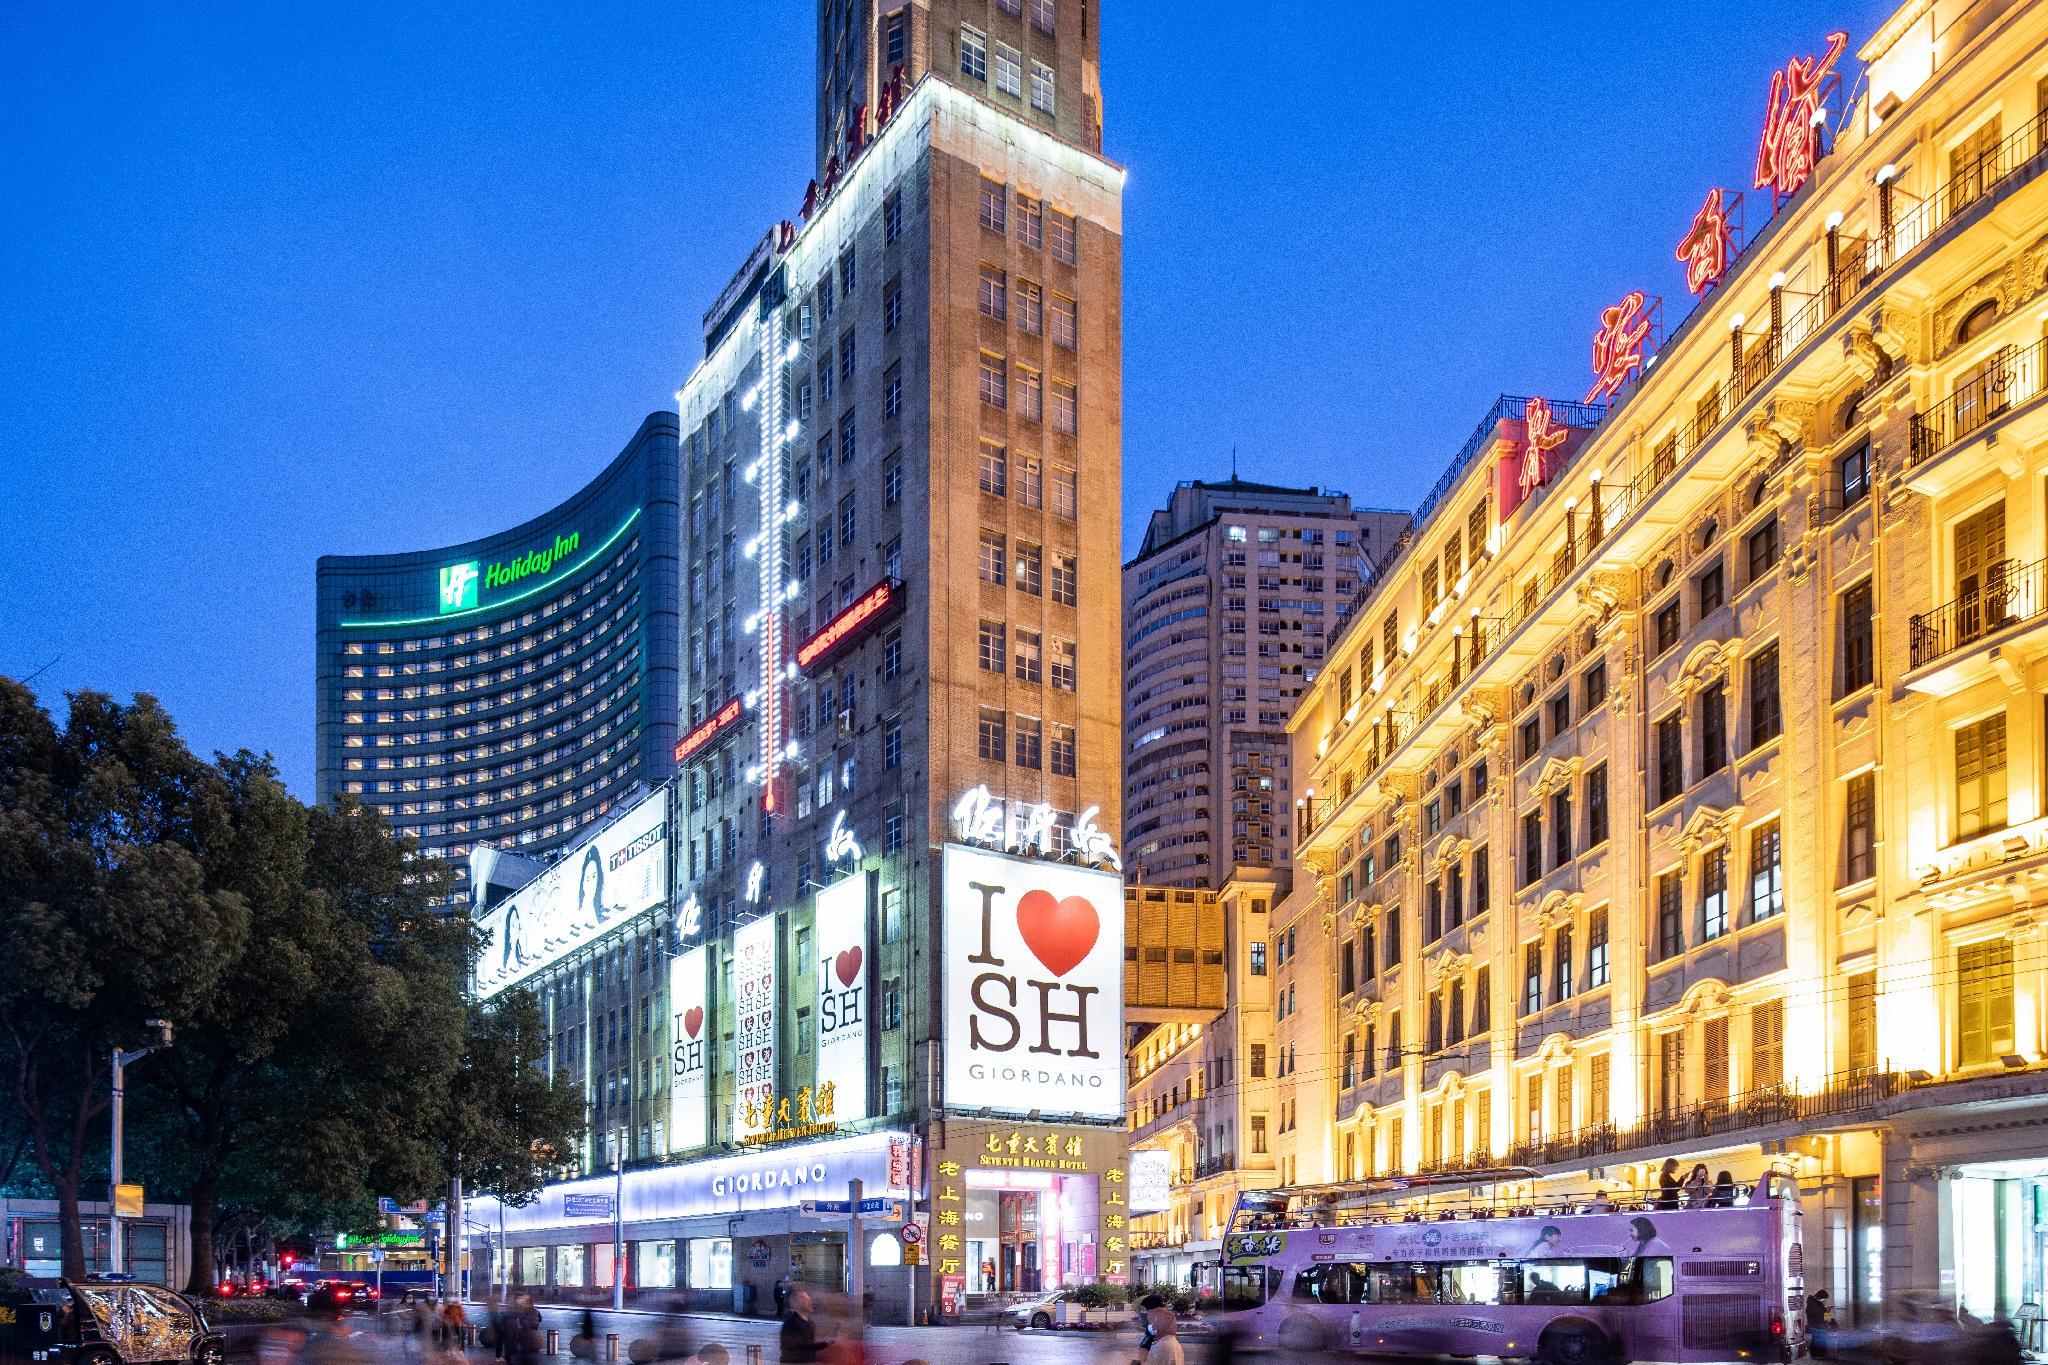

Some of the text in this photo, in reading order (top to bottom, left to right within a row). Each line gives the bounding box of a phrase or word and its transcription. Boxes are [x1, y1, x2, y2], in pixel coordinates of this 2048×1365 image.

[485, 531, 580, 589] Holiday Inn
[627, 824, 664, 861] TISSOT
[967, 881, 1005, 966] I
[821, 956, 833, 995] I
[674, 1013, 683, 1044] I
[821, 986, 862, 1034] SH
[970, 972, 1099, 1059] SH
[674, 1039, 704, 1076] SH
[821, 1029, 863, 1048] GIORDANO
[969, 1064, 1102, 1088] GIORDANO
[711, 1163, 826, 1197] GIORDANO
[938, 1160, 961, 1274] 老上海餐厅
[1105, 1168, 1125, 1275] 老上海餐厅
[32, 1350, 48, 1361] 特警
